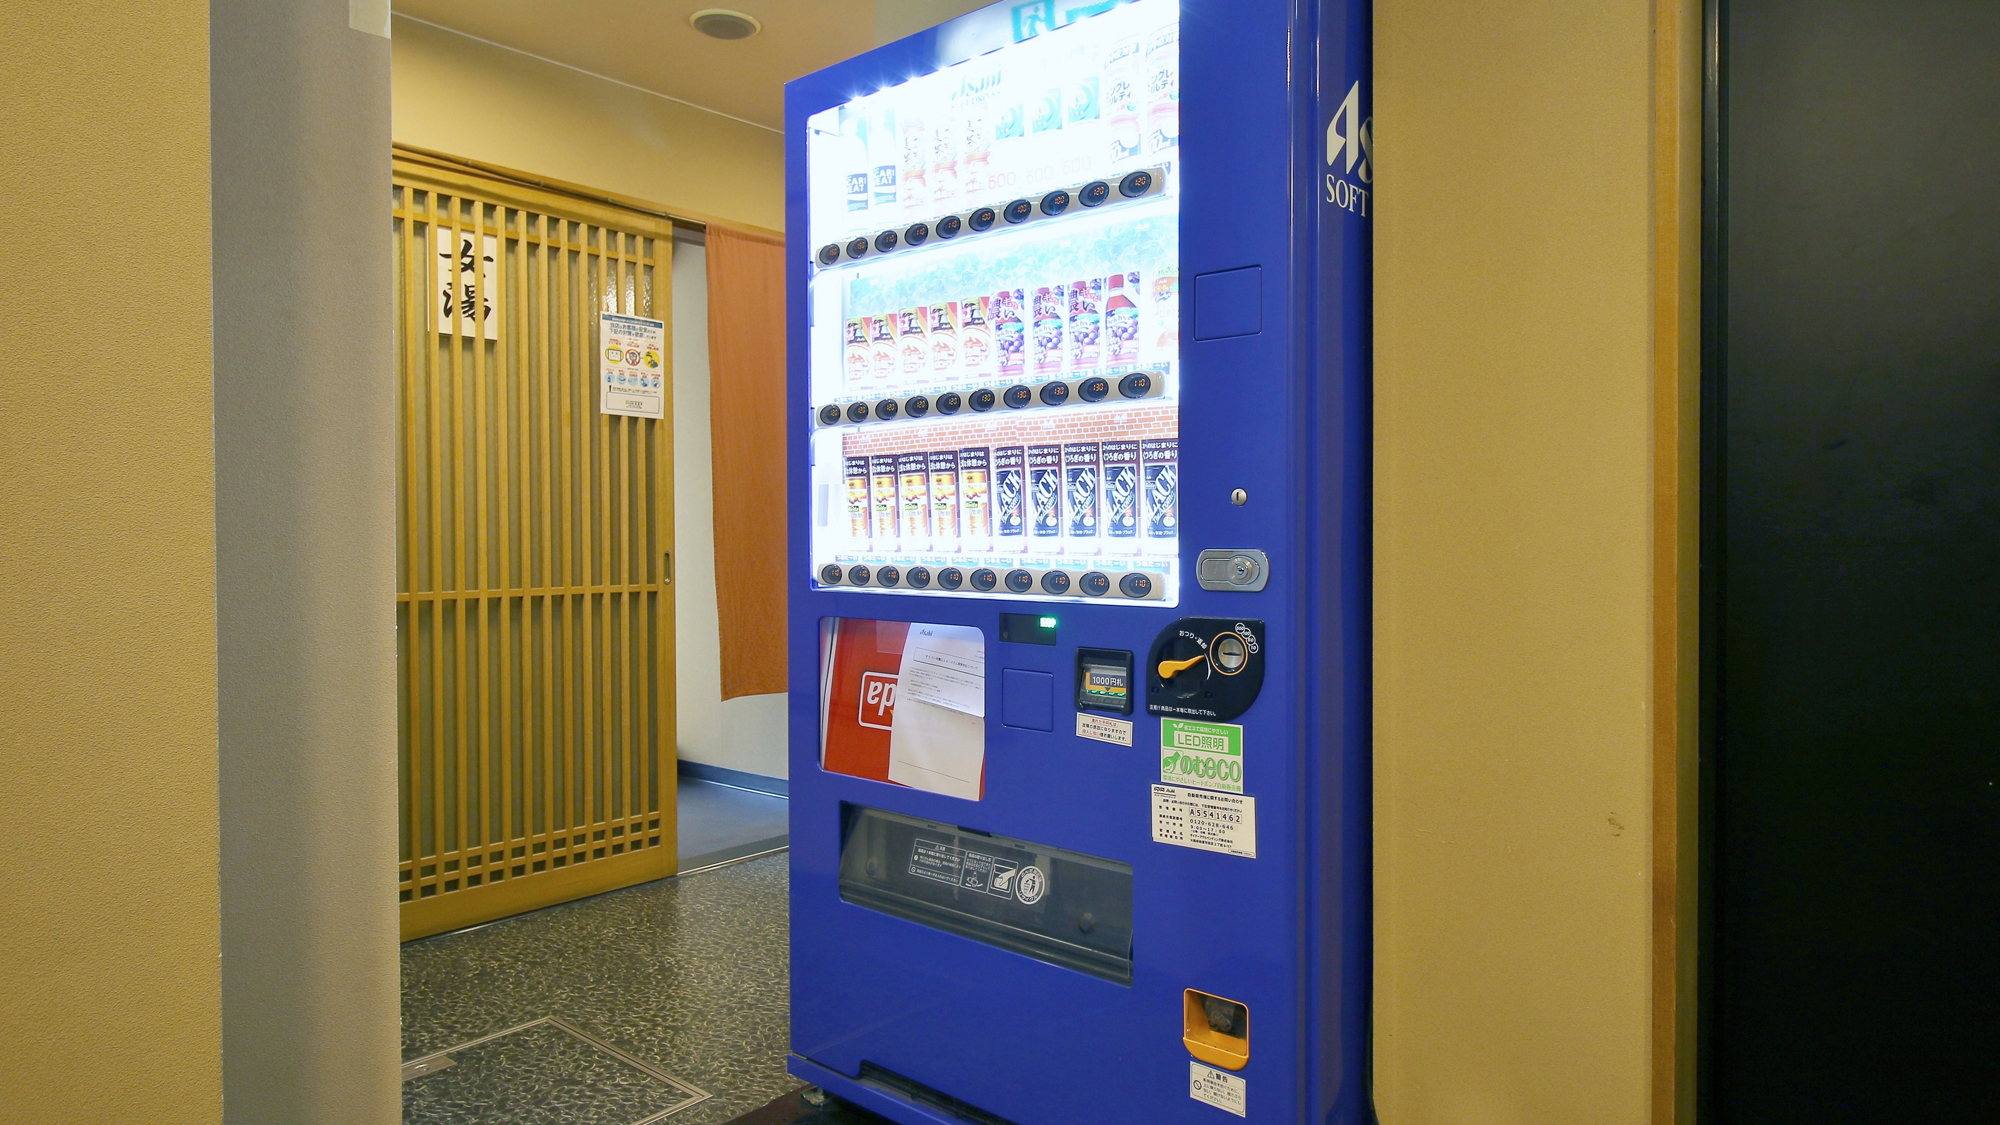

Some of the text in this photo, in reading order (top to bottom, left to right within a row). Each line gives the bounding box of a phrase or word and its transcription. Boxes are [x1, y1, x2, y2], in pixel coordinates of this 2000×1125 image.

[1135, 176, 1146, 186] 120
[1326, 174, 1370, 217] SOFT
[1093, 382, 1104, 391] 130
[1134, 378, 1145, 387] 110
[1017, 390, 1027, 399] 130
[1054, 386, 1065, 395] 130
[1055, 576, 1066, 585] 110
[1094, 577, 1105, 586] 110
[1135, 578, 1147, 588] 110
[1092, 676, 1124, 687] 1000円札
[1184, 724, 1229, 736] 省エネで環境にやさしい
[1177, 733, 1225, 751] LED照明
[1179, 754, 1242, 783] のむeco
[1189, 808, 1241, 824] A5541462
